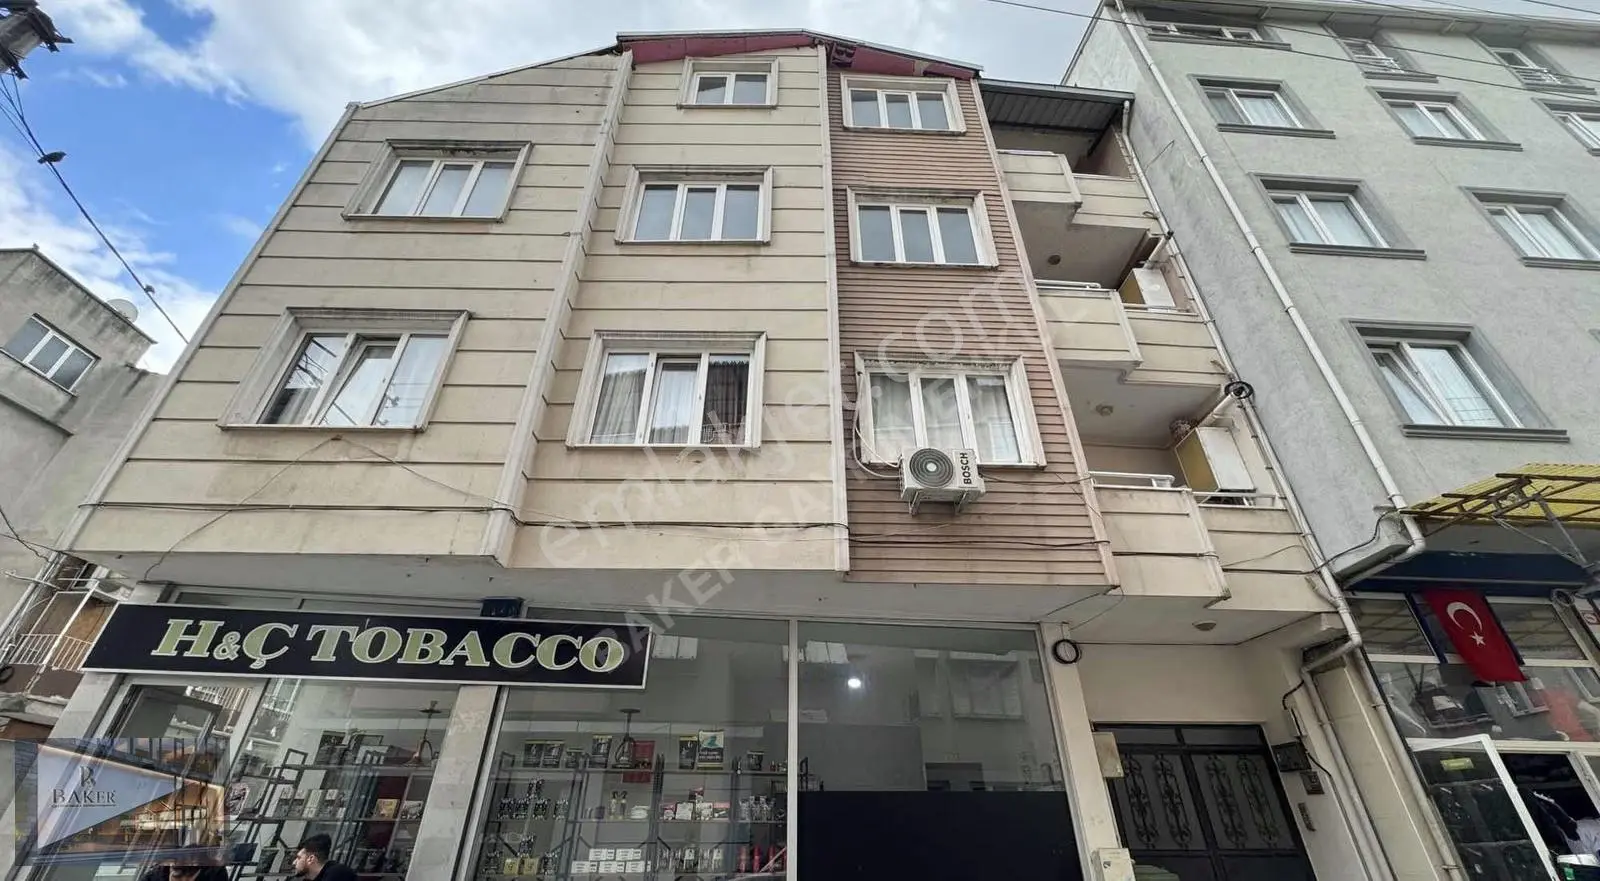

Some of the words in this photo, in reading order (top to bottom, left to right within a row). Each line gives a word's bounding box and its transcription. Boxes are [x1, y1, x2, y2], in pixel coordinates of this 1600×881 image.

[960, 452, 972, 485] BOSCH
[150, 618, 299, 669] H&Ç
[306, 624, 625, 673] TOBACCO
